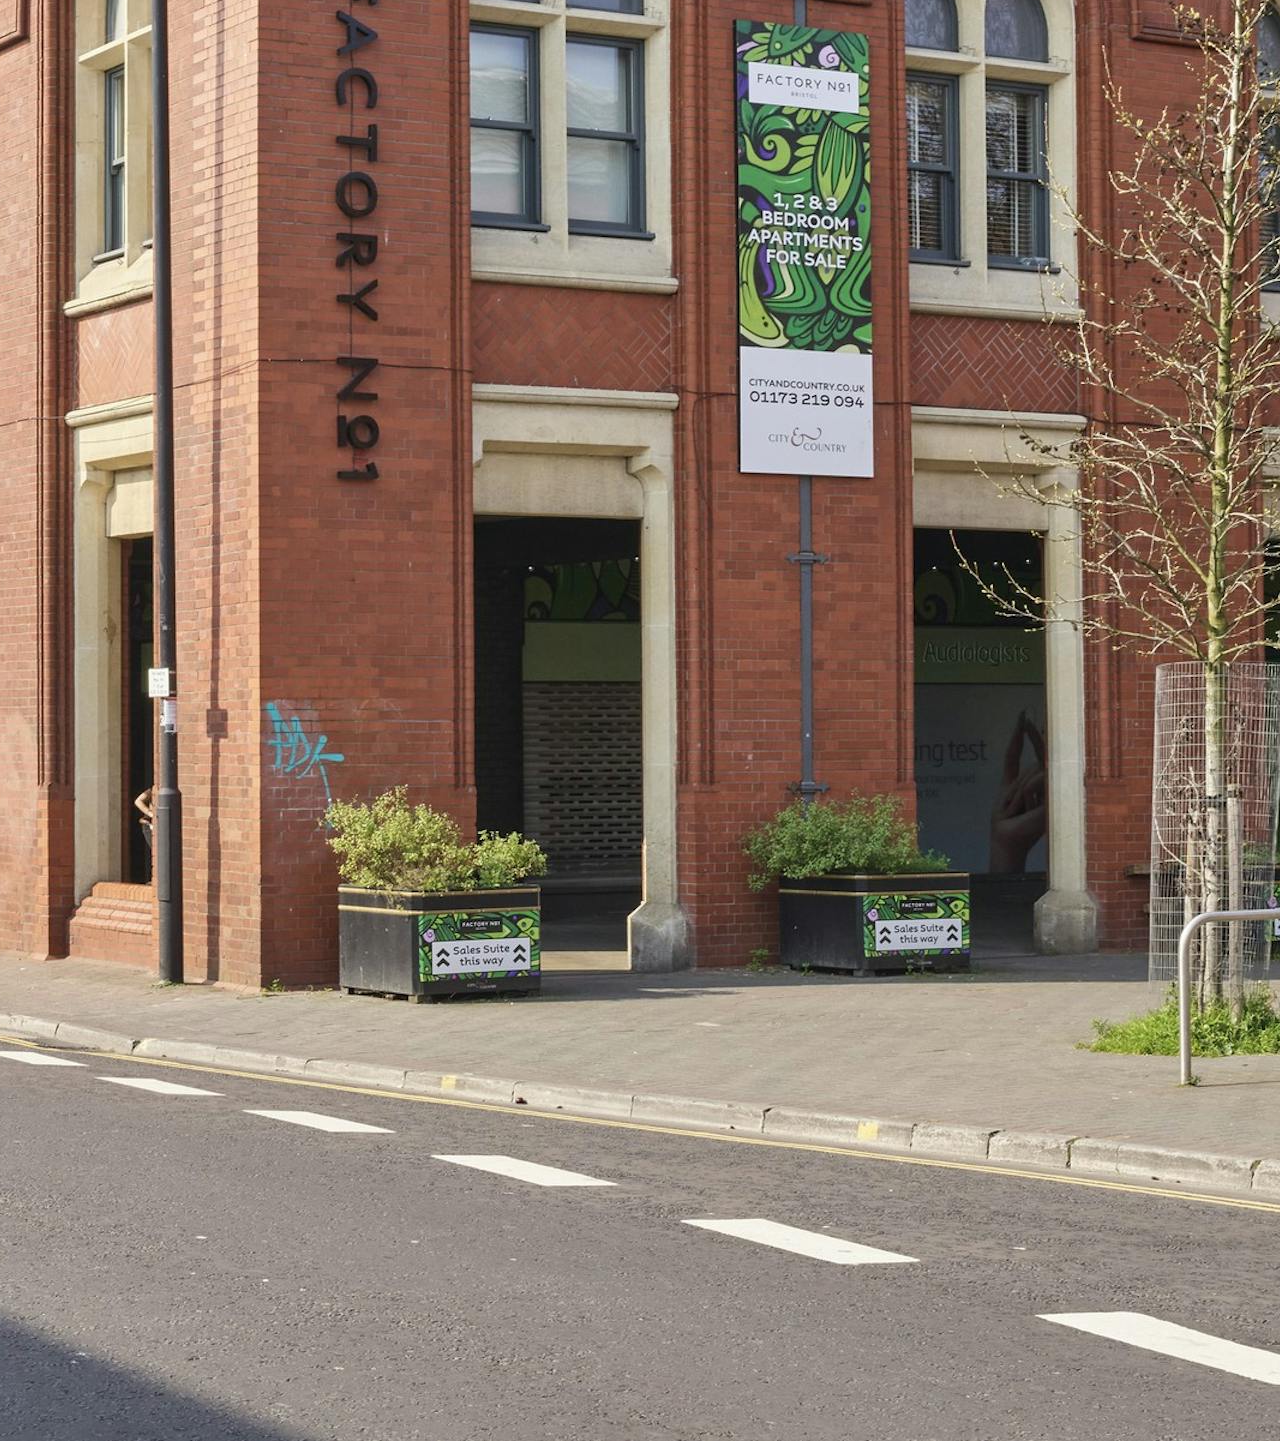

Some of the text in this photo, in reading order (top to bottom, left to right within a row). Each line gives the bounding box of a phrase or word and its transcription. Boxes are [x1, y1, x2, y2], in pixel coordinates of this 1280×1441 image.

[757, 73, 822, 89] FACTORY
[791, 91, 818, 99] BRISTOL
[773, 192, 838, 211] 1, 2 & 3
[762, 210, 849, 231] BEDROOM
[748, 228, 863, 251] APARTMENTS
[766, 249, 846, 269] FOR SALE
[748, 378, 865, 392] CITYANDCOUNTRY.CO.UK
[749, 390, 864, 408] 01173 219 094
[768, 433, 789, 443] CITY
[803, 442, 848, 453] COUNTRY
[922, 640, 1031, 667] Audiologists
[948, 739, 989, 761] test
[462, 920, 489, 928] FACTORY
[894, 923, 945, 934] Sales Suite
[900, 935, 939, 945] this way
[453, 943, 510, 956] Sales Suite
[460, 956, 504, 967] this way
